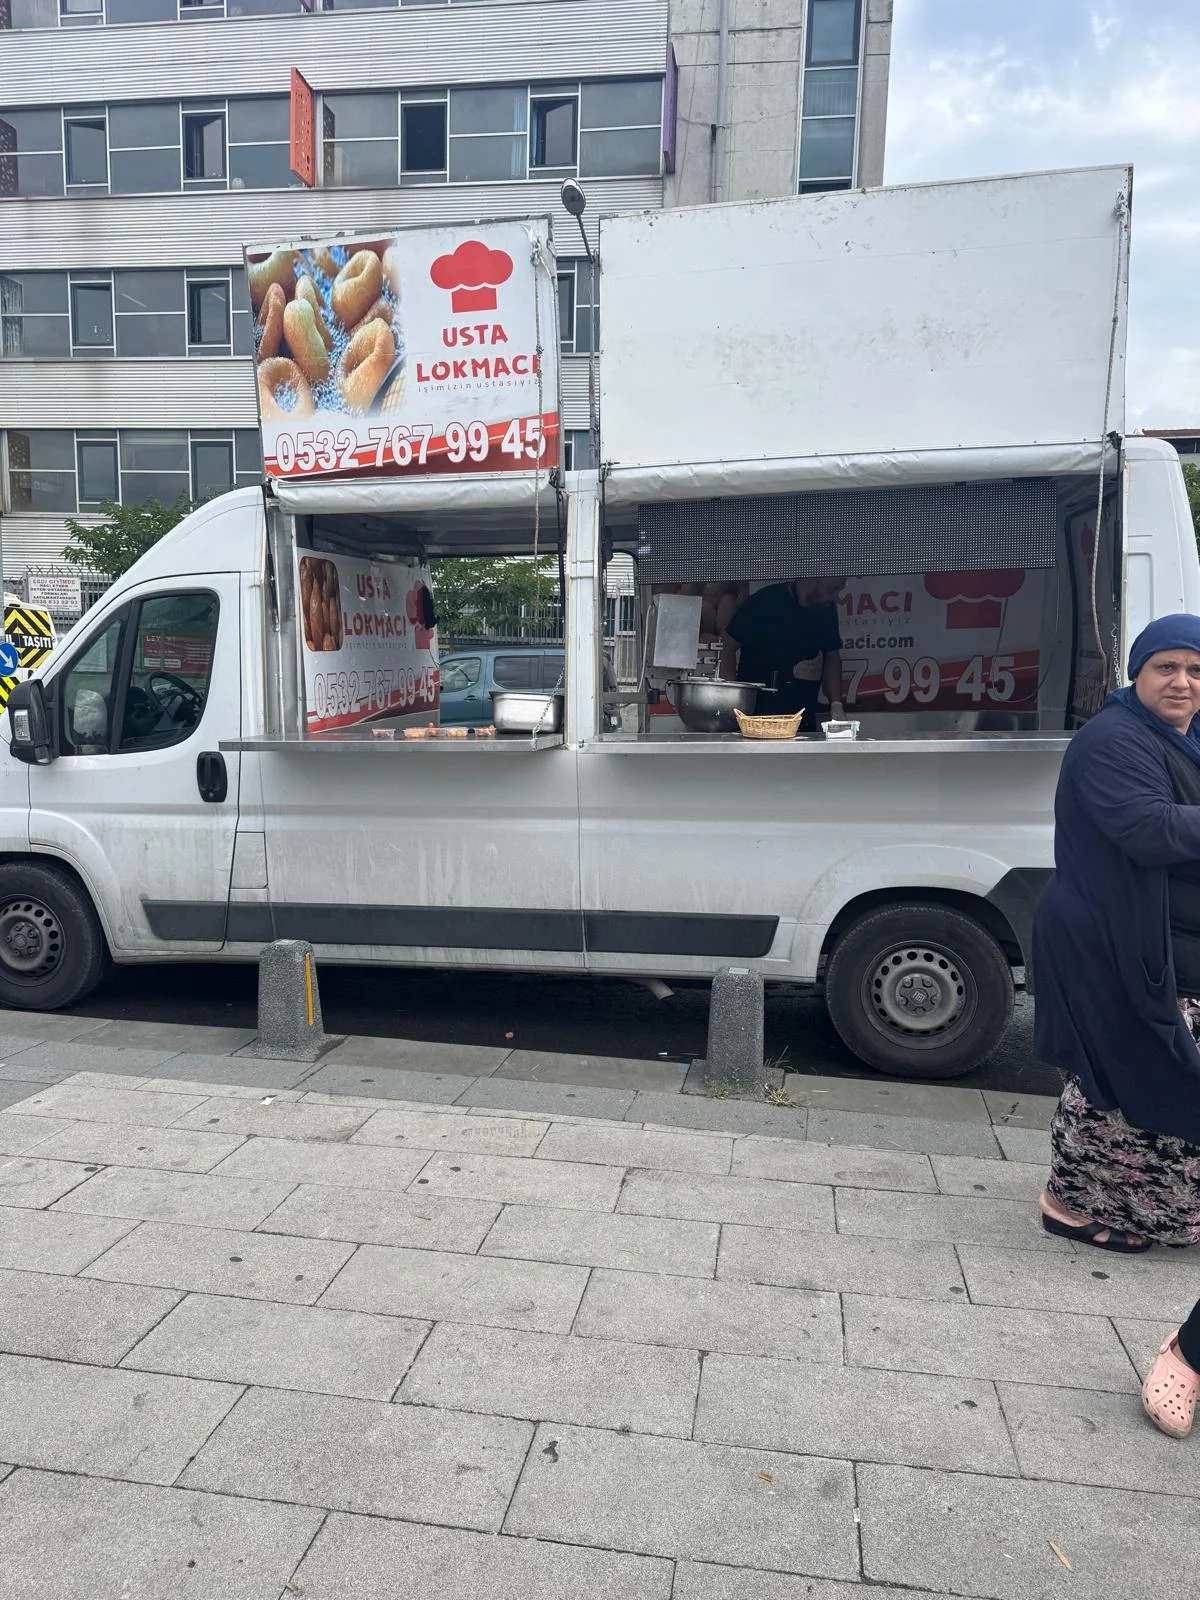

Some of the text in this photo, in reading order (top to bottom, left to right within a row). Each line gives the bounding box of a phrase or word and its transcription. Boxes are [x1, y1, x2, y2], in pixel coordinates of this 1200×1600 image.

[442, 324, 508, 348] USTA
[416, 354, 541, 383] LOKMACI
[418, 382, 472, 394] işimizin
[276, 417, 546, 472] 0532 767 99 45
[356, 574, 392, 601] USTA
[837, 591, 913, 617] MACI
[343, 612, 407, 639] LOKMACI
[22, 635, 52, 649] TAŞITI
[314, 666, 436, 719] 0532 767 99 45
[883, 656, 941, 704] 99
[956, 654, 1016, 702] 45
